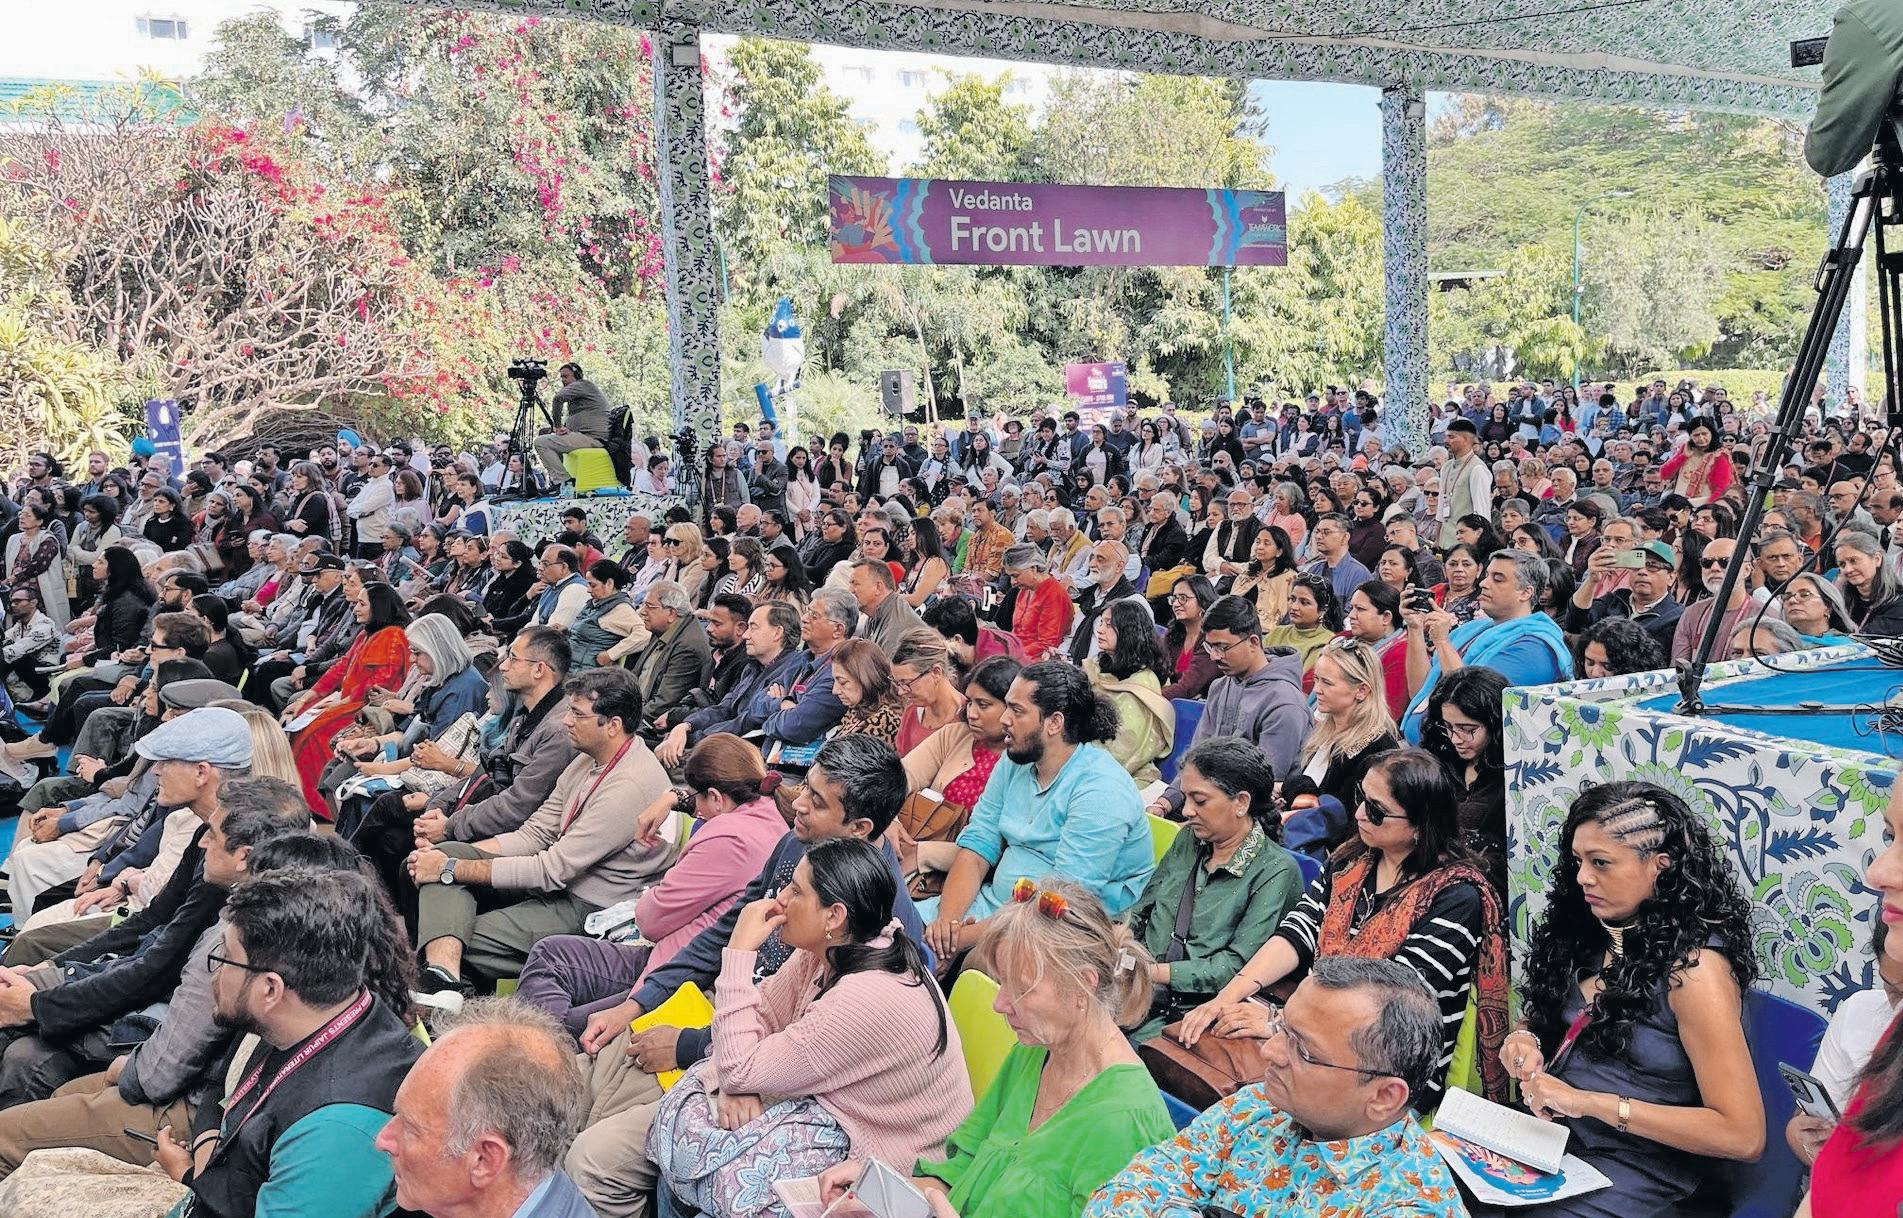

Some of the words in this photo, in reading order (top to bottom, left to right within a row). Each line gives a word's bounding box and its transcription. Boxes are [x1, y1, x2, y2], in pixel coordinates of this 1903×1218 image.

[949, 188, 1033, 211] Vedanta
[951, 216, 1044, 252] Front
[1054, 218, 1141, 253] Lawn
[328, 1004, 362, 1035] PRESENTS
[303, 1032, 329, 1056] JAIPUR
